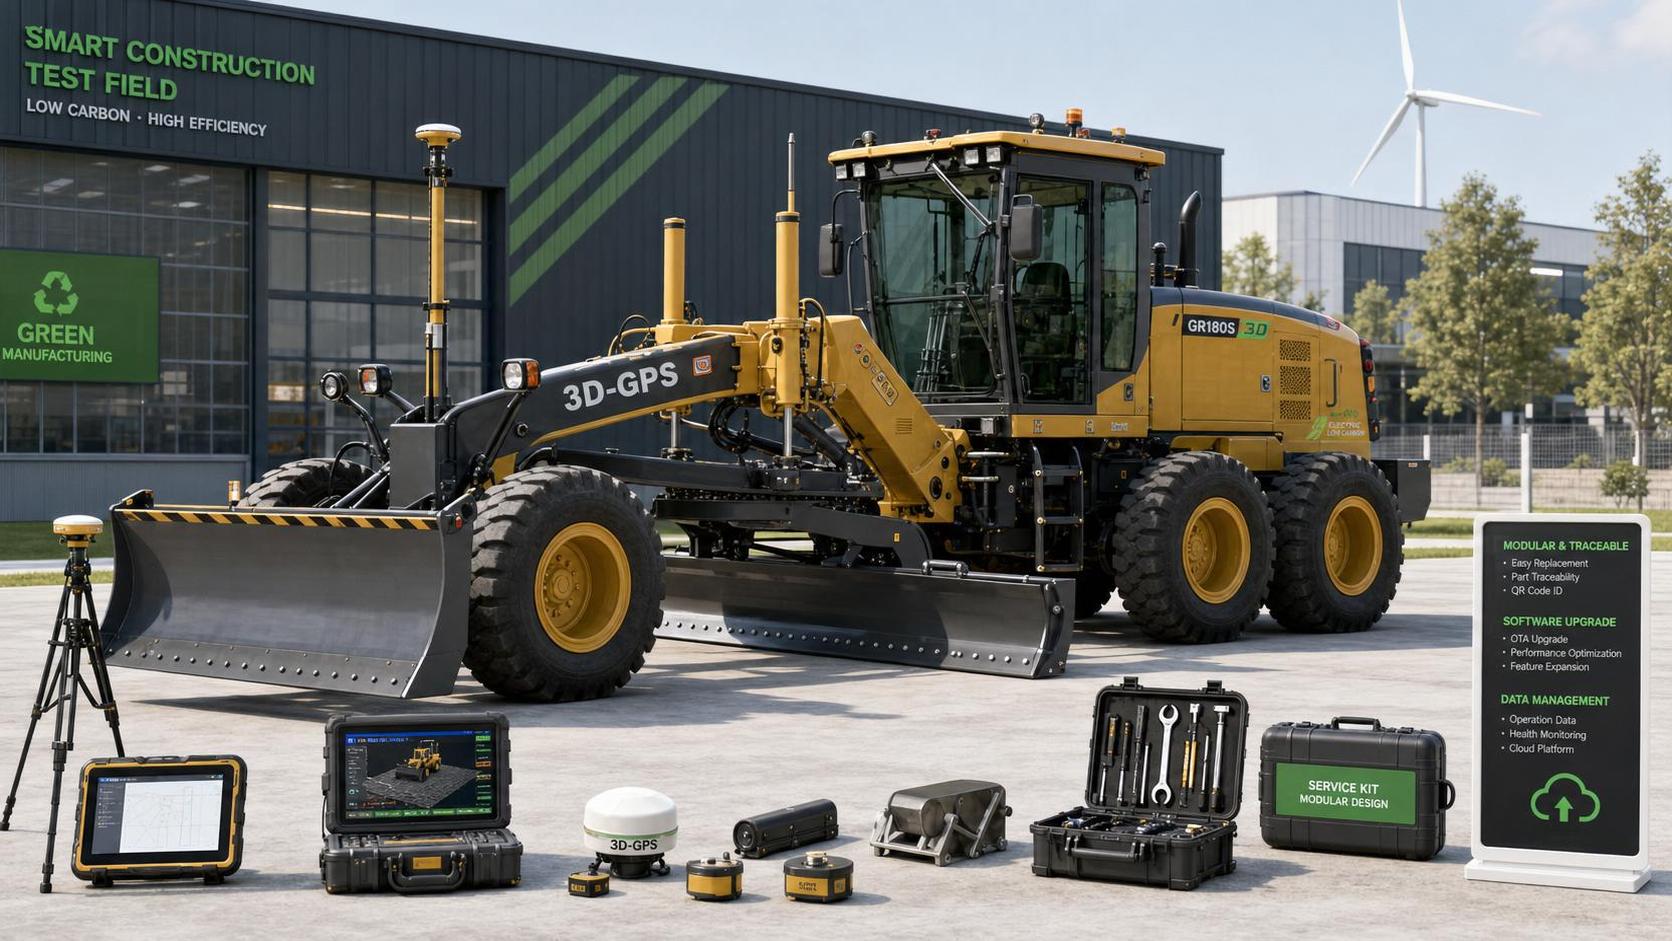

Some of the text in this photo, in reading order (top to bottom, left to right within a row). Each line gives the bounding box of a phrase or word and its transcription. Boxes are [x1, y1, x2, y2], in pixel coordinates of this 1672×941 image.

[24, 25, 316, 86] SMART CONSTRUCTION
[24, 61, 178, 100] TEST FIELD
[26, 98, 267, 136] LOW CARBON HIGH EFFICIENCY
[17, 322, 94, 345] GREEN
[1188, 320, 1267, 336] GR180S 3D
[2, 348, 112, 363] MANUFACTURING
[563, 362, 678, 411] 3D-GPS
[1504, 541, 1629, 551] MODULAR & TRACEABLE
[1512, 559, 1588, 569] Easy Replacement
[1512, 573, 1580, 583] Part Traceability
[1511, 586, 1563, 595] QR Code ID
[1503, 616, 1616, 627] SOFTWARE UPGRADE
[1510, 634, 1568, 645] OTA Upgrade
[1511, 648, 1622, 659] Performance Optimization
[1511, 662, 1589, 672] Feature Expansion
[1501, 695, 1610, 706] DATA MANAGEMENT
[1510, 715, 1576, 725] Operation Data
[1510, 729, 1587, 741] Health Monitoring
[1509, 744, 1574, 754] Cloud Platform
[1308, 780, 1379, 794] SERVICE KIT
[1300, 794, 1389, 809] MODULAR DESIGN
[610, 839, 658, 851] 3D-GPS
